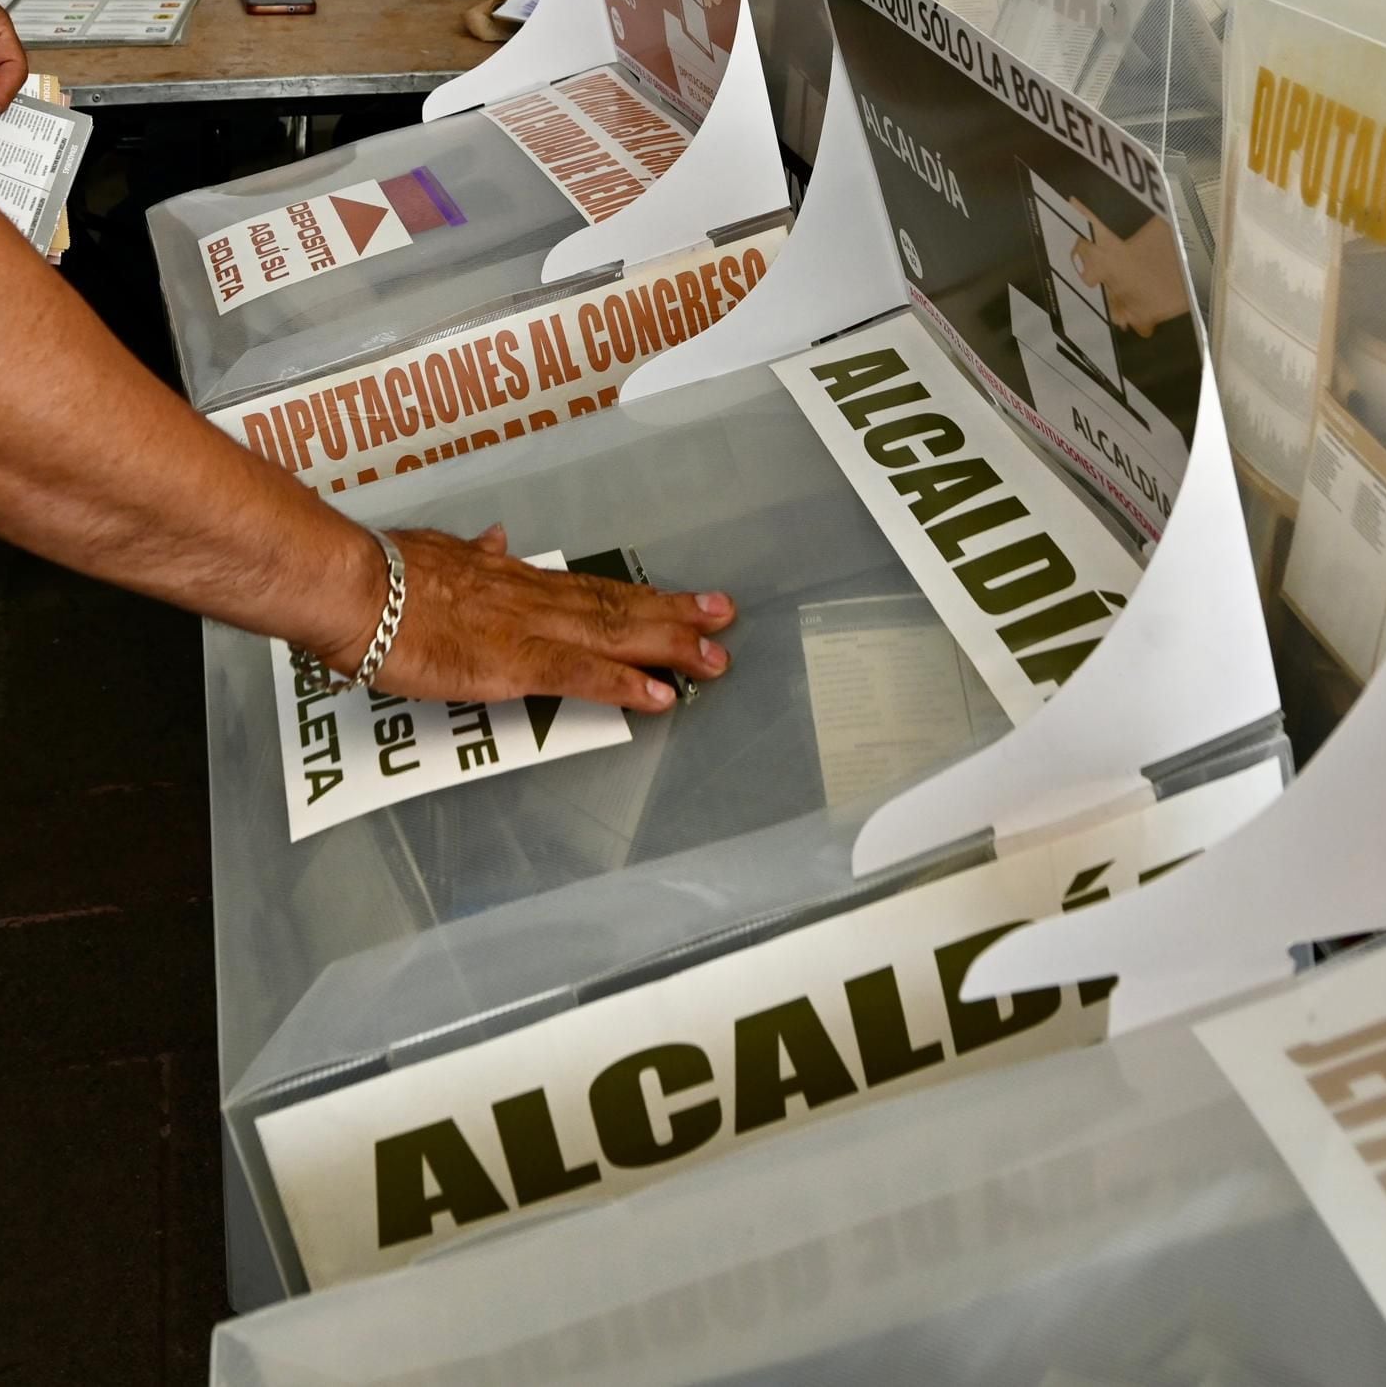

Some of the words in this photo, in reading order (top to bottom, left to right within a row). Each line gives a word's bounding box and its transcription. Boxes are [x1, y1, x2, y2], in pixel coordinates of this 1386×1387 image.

[510, 112, 601, 165] CIUDAD
[555, 72, 672, 139] DIPUTACIONES
[618, 130, 687, 153] AL
[917, 0, 975, 74] SÓLO
[976, 39, 1011, 97] LA
[1012, 64, 1118, 166] BOLETA
[1123, 137, 1167, 212] DE
[548, 150, 619, 182] DE
[860, 92, 972, 220] ALCALDÍA
[206, 236, 245, 303] BOLETA
[246, 221, 288, 262] AQUÍ
[261, 256, 290, 282] SU
[285, 200, 338, 273] DEPOSITE
[240, 328, 532, 478] DIPUTACIONES
[526, 312, 583, 391] AL
[974, 358, 1011, 403] GENERAL
[1010, 393, 1024, 416] DE
[1022, 403, 1101, 483] INSTITUCIONES
[1071, 405, 1172, 520] ALCALDÍA
[373, 711, 421, 778] SU
